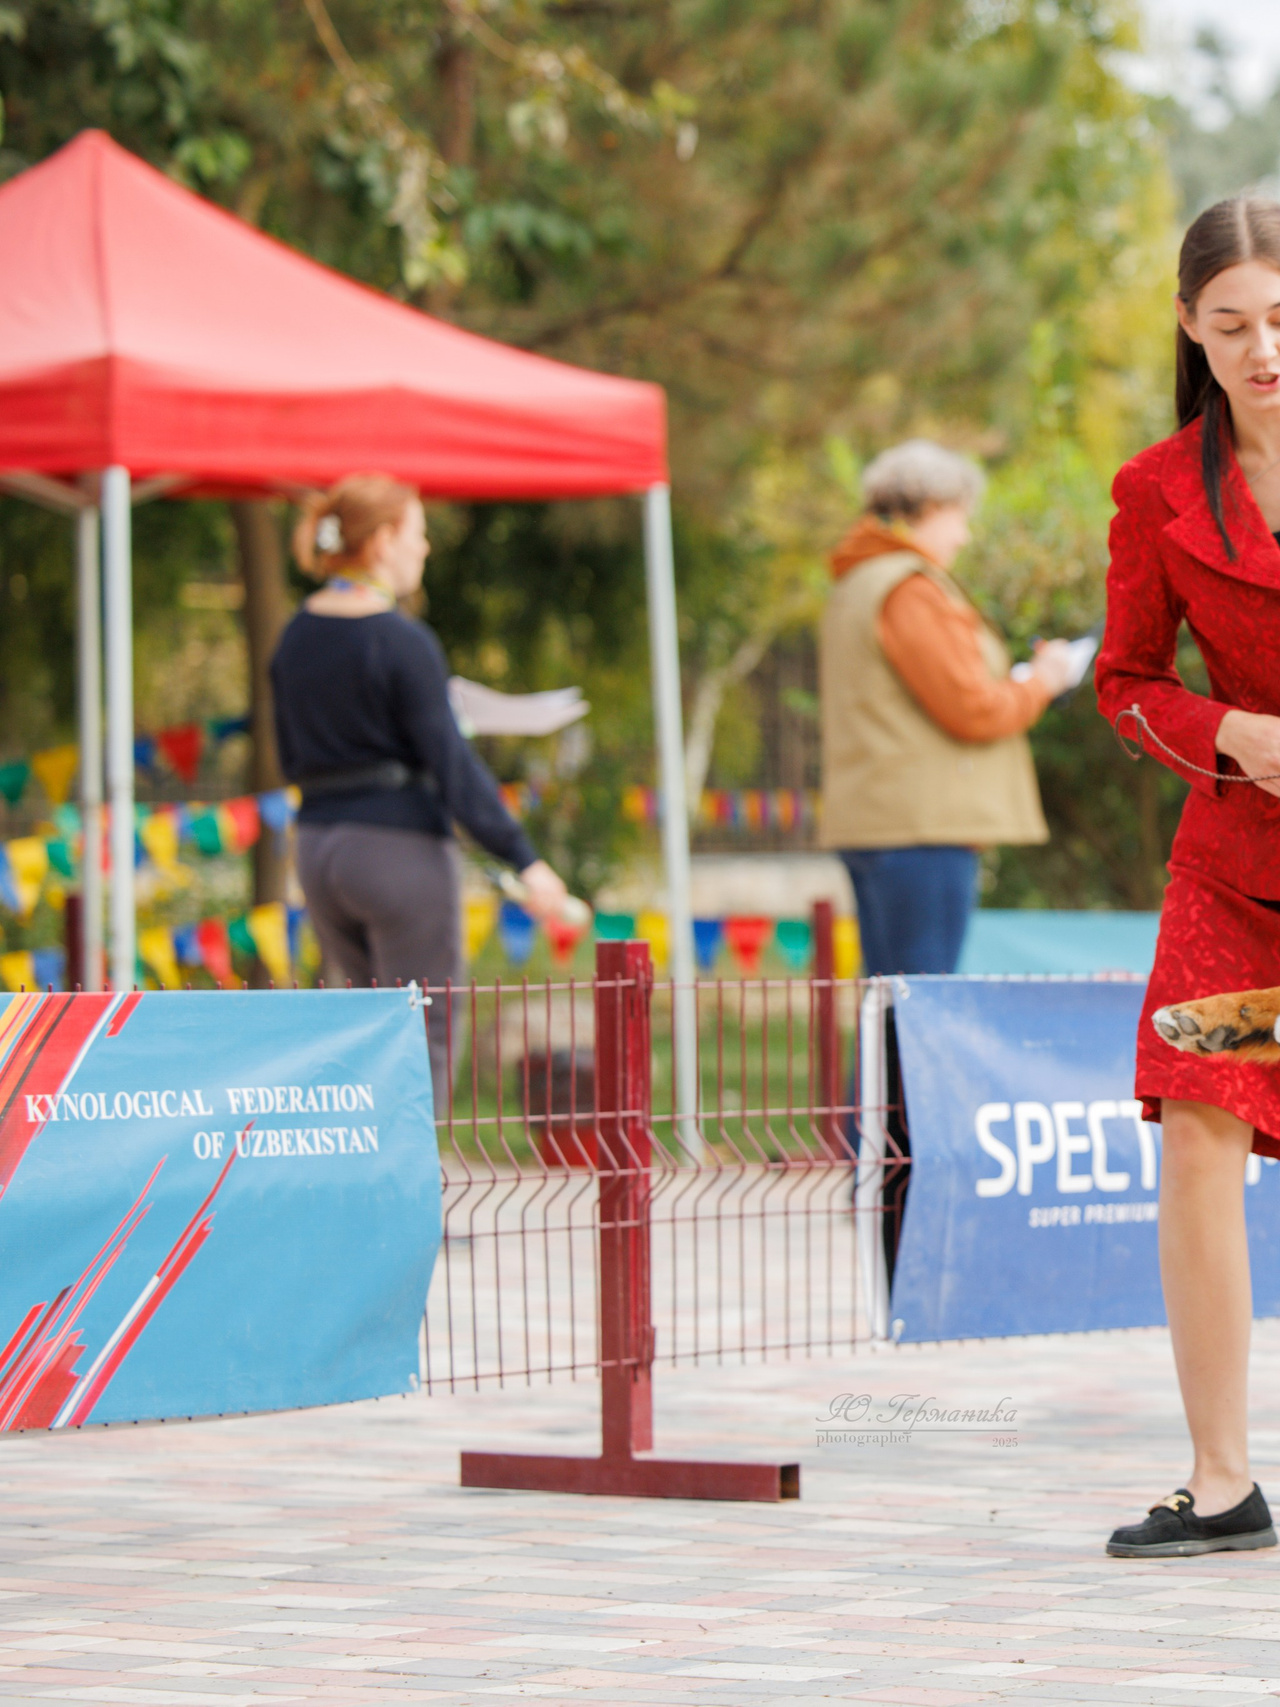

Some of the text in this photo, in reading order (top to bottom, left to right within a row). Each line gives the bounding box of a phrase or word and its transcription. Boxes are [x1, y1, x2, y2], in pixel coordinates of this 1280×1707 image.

[24, 1083, 376, 1123] KYNOLOGICAL FEDERATION
[192, 1125, 380, 1160] OF UZBEKISTAN
[1028, 1202, 1159, 1228] SUPER PREMIUM
